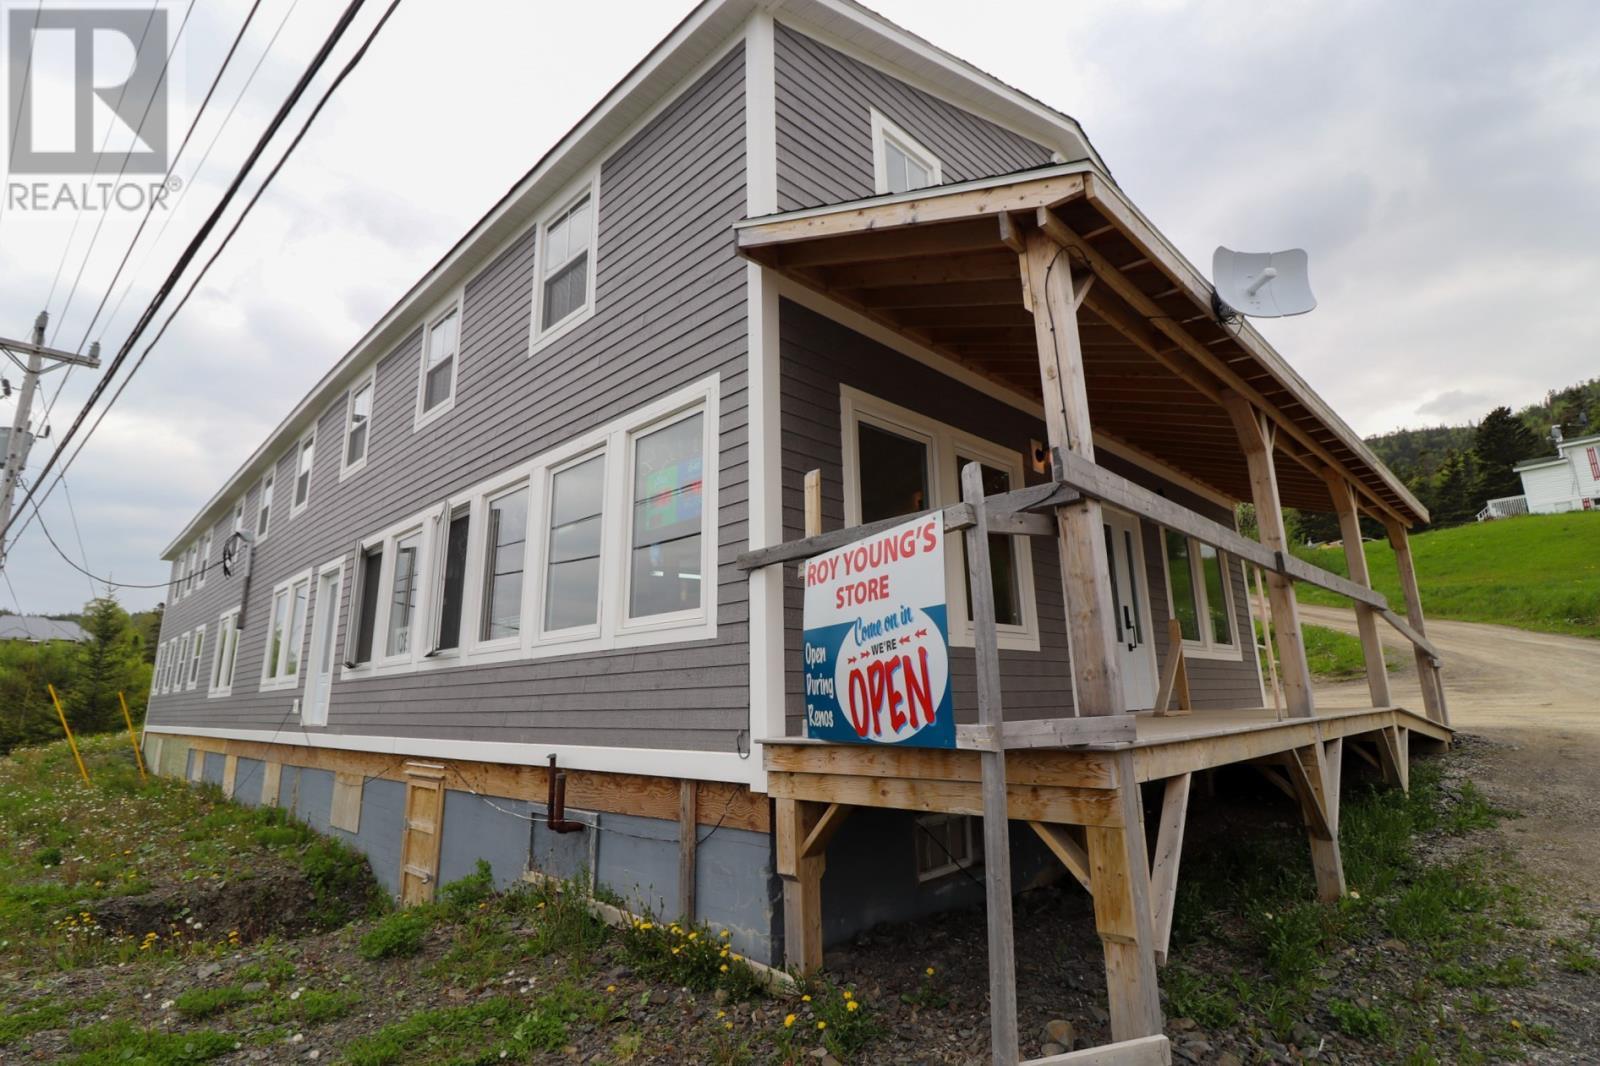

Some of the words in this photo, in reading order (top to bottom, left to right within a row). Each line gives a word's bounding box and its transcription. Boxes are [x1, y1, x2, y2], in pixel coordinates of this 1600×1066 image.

[807, 558, 840, 587] ROY
[843, 522, 937, 576] YOUNG'S
[836, 575, 890, 609] STORE
[853, 616, 883, 647] Come
[884, 613, 900, 633] on
[901, 605, 914, 624] in
[805, 642, 827, 665] Open
[871, 638, 897, 656] WE'RE
[806, 673, 834, 698] During
[849, 646, 936, 737] OPEN
[808, 703, 834, 728] Renos
